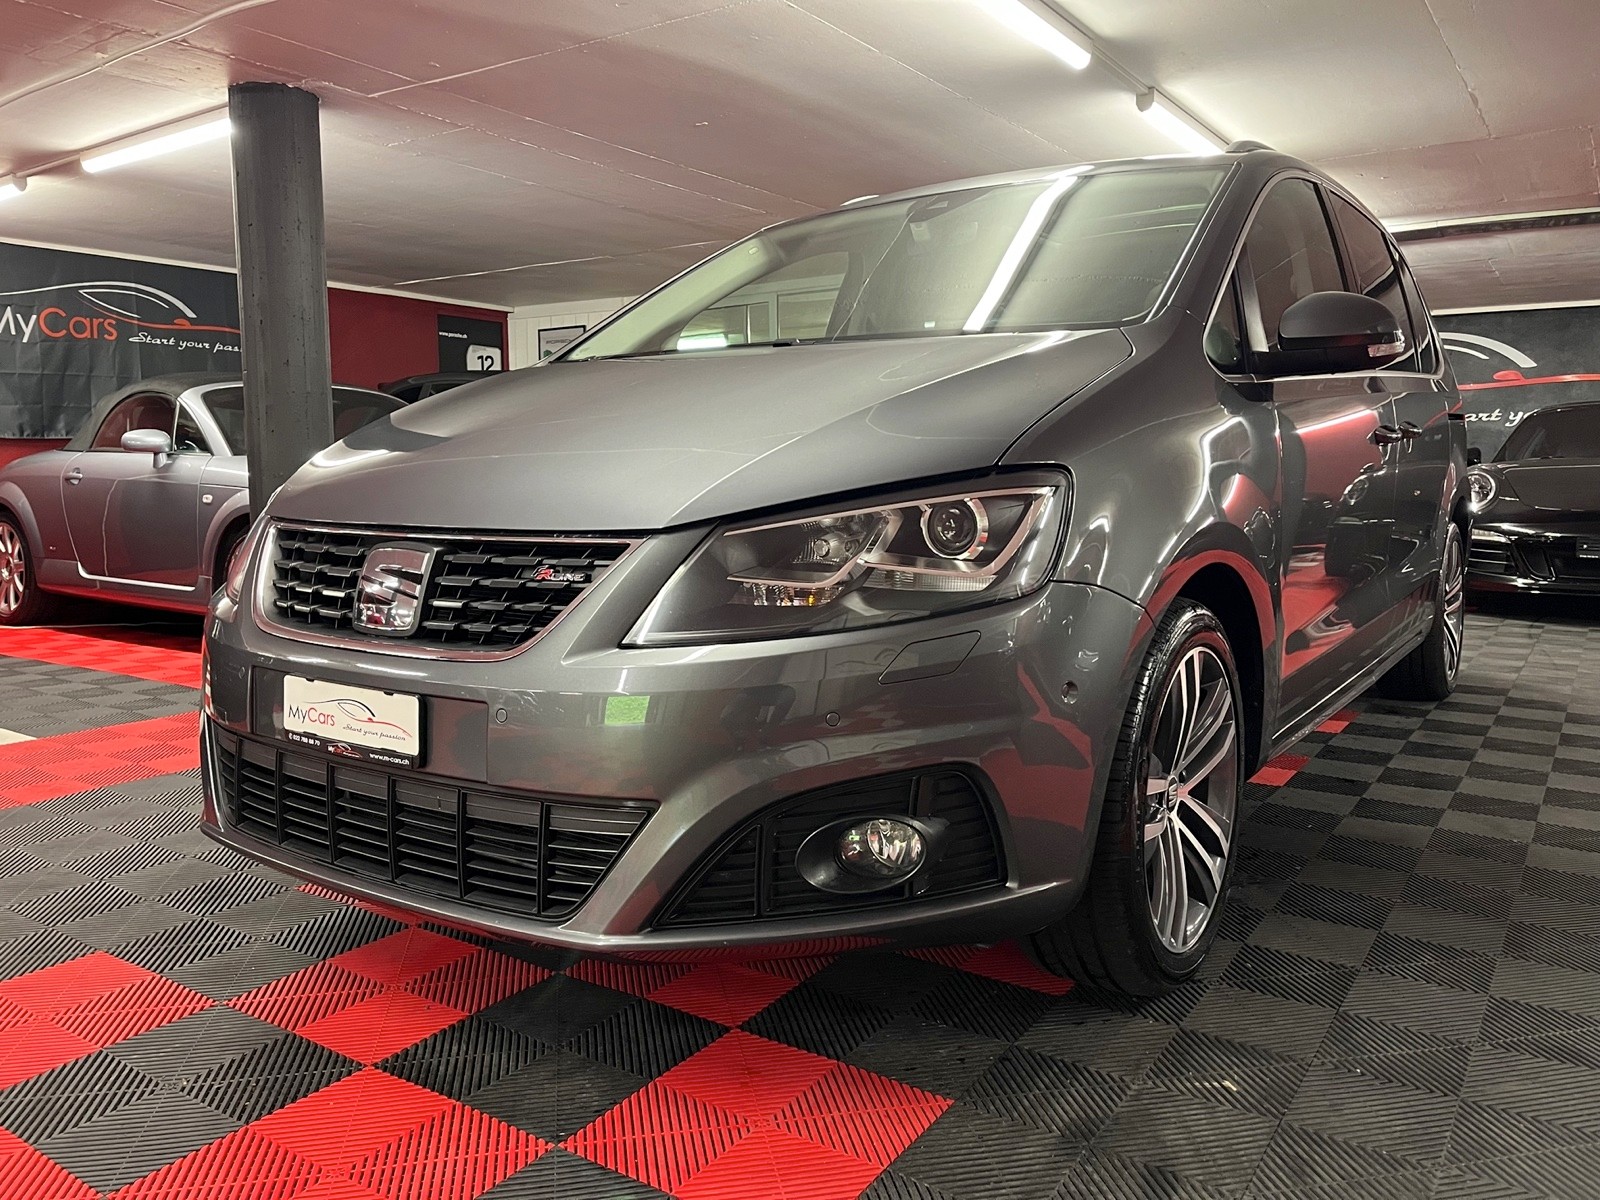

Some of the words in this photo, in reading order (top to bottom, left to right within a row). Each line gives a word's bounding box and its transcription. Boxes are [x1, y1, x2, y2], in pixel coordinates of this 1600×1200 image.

[128, 331, 176, 346] Start
[178, 339, 210, 350] your
[477, 355, 494, 371] 12
[288, 704, 336, 727] MyCars
[342, 723, 362, 733] Start
[363, 729, 378, 737] your
[379, 732, 406, 741] passion
[368, 752, 410, 765] www.m-cars.ch
